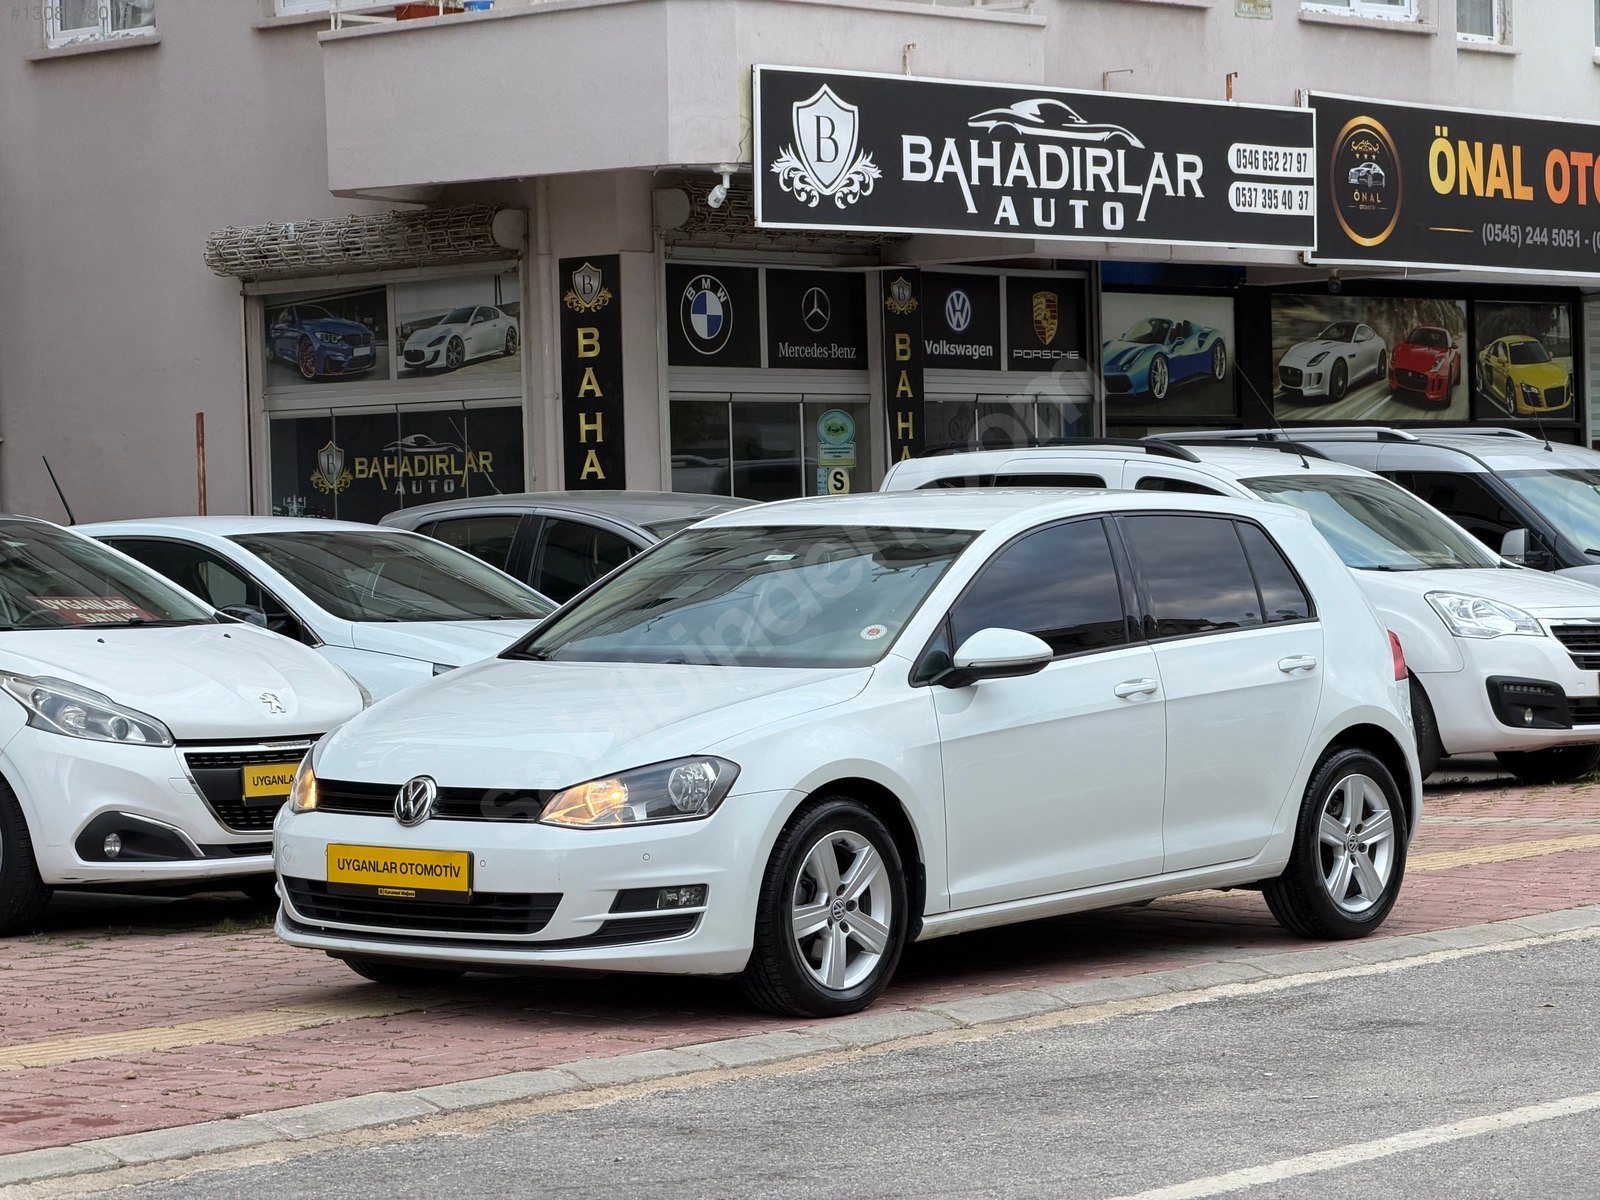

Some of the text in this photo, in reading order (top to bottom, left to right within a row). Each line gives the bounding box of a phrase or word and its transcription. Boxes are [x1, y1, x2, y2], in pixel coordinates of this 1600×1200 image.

[814, 115, 840, 163] B
[1236, 148, 1307, 173] 0546 652 27 97
[1428, 125, 1600, 206] ÖNAL OT
[901, 134, 1206, 222] BAHADIRLAR
[1235, 186, 1309, 210] 0537 395 40 37
[1353, 189, 1381, 203] ÖNAL
[994, 196, 1125, 231] AUTO
[1482, 222, 1522, 248] (0545)
[1525, 226, 1549, 246] 244
[1551, 228, 1580, 248] 5051
[582, 274, 593, 295] B
[686, 278, 728, 301] BMW
[778, 342, 857, 359] Mercedes-Benz
[924, 340, 994, 360] Volkswagen
[1012, 349, 1080, 360] PORSCHE
[354, 451, 494, 491] BAHADIRLAR
[832, 470, 845, 491] S
[394, 478, 456, 496] AUTO
[337, 858, 461, 878] UYGANLAR OTOMOTİV
